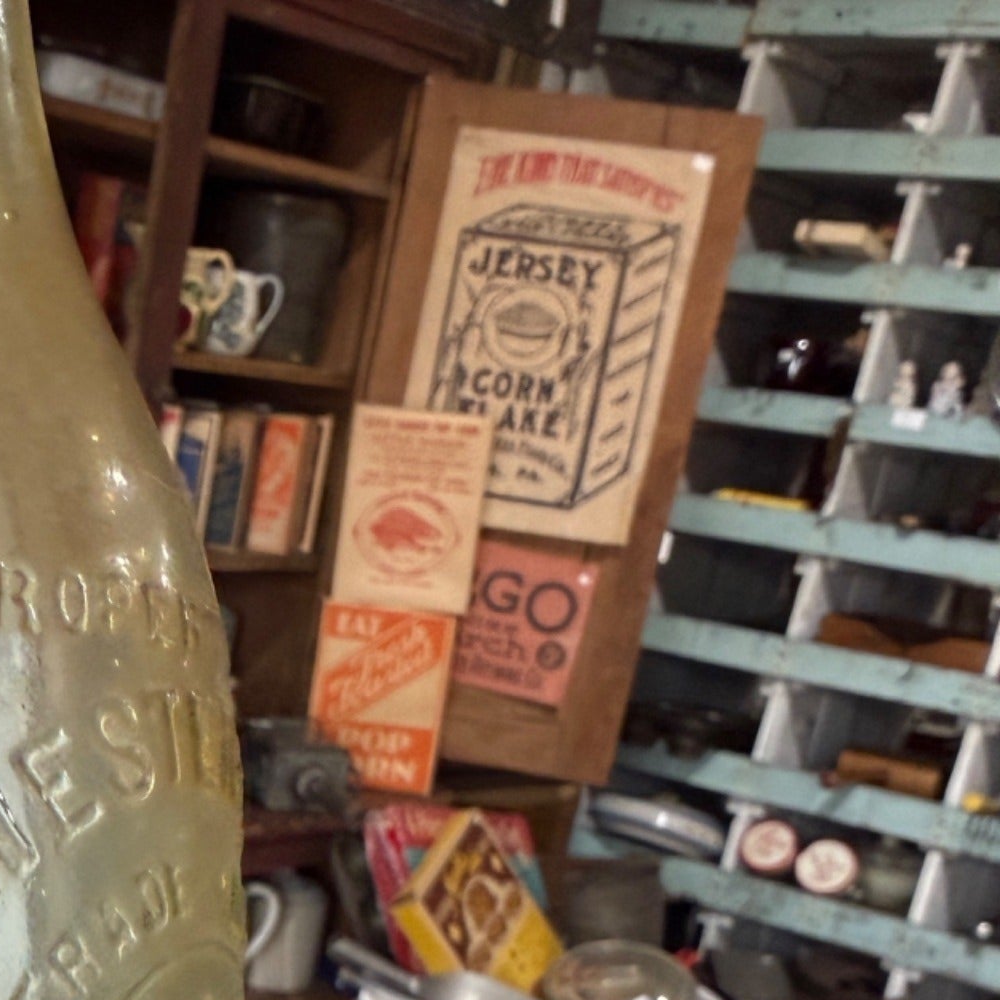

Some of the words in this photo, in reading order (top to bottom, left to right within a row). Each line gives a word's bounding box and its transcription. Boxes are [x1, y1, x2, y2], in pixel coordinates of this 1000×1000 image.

[468, 247, 601, 290] JERSEY
[472, 368, 559, 403] CORN
[474, 568, 578, 634] GO
[336, 611, 382, 638] EAT
[337, 725, 412, 756] POP
